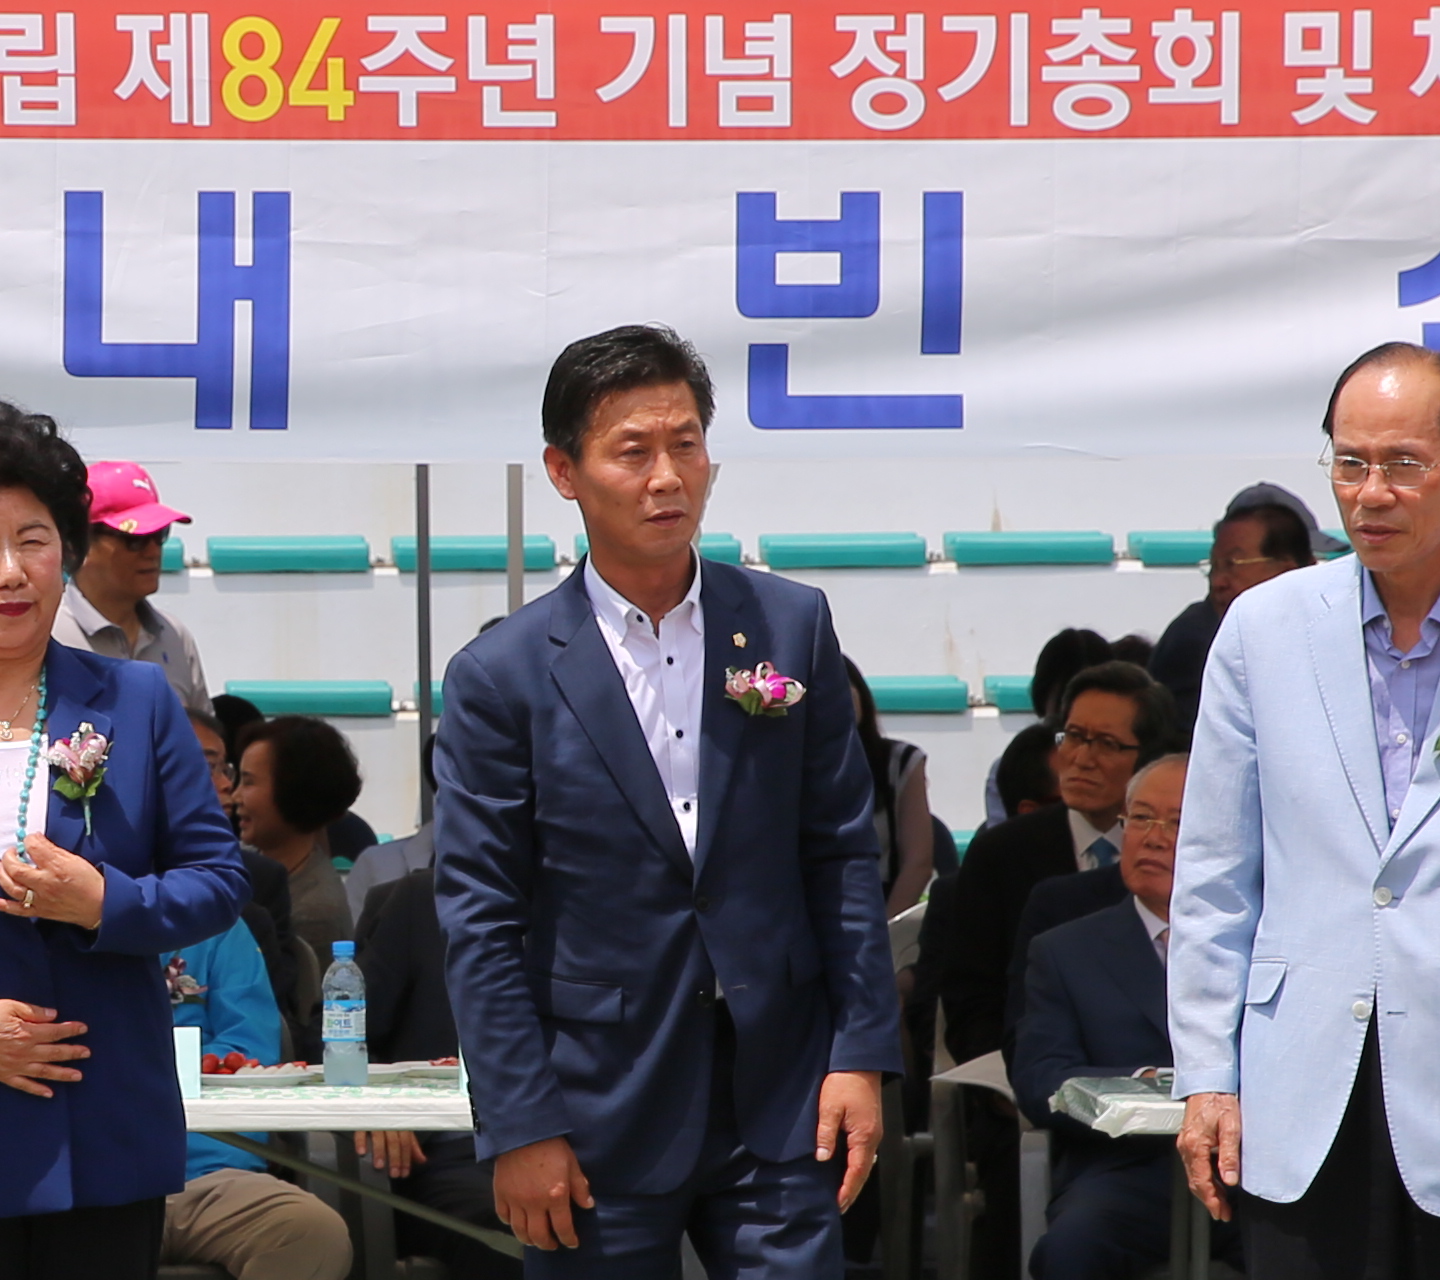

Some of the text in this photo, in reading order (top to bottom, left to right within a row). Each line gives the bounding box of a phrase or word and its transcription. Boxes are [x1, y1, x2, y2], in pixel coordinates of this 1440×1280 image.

[114, 11, 556, 127] 제84주년
[596, 11, 791, 127] 기념
[831, 6, 1239, 130] 정기총회
[1284, 10, 1377, 124] 및
[65, 192, 321, 429] 내
[738, 193, 962, 429] 빈
